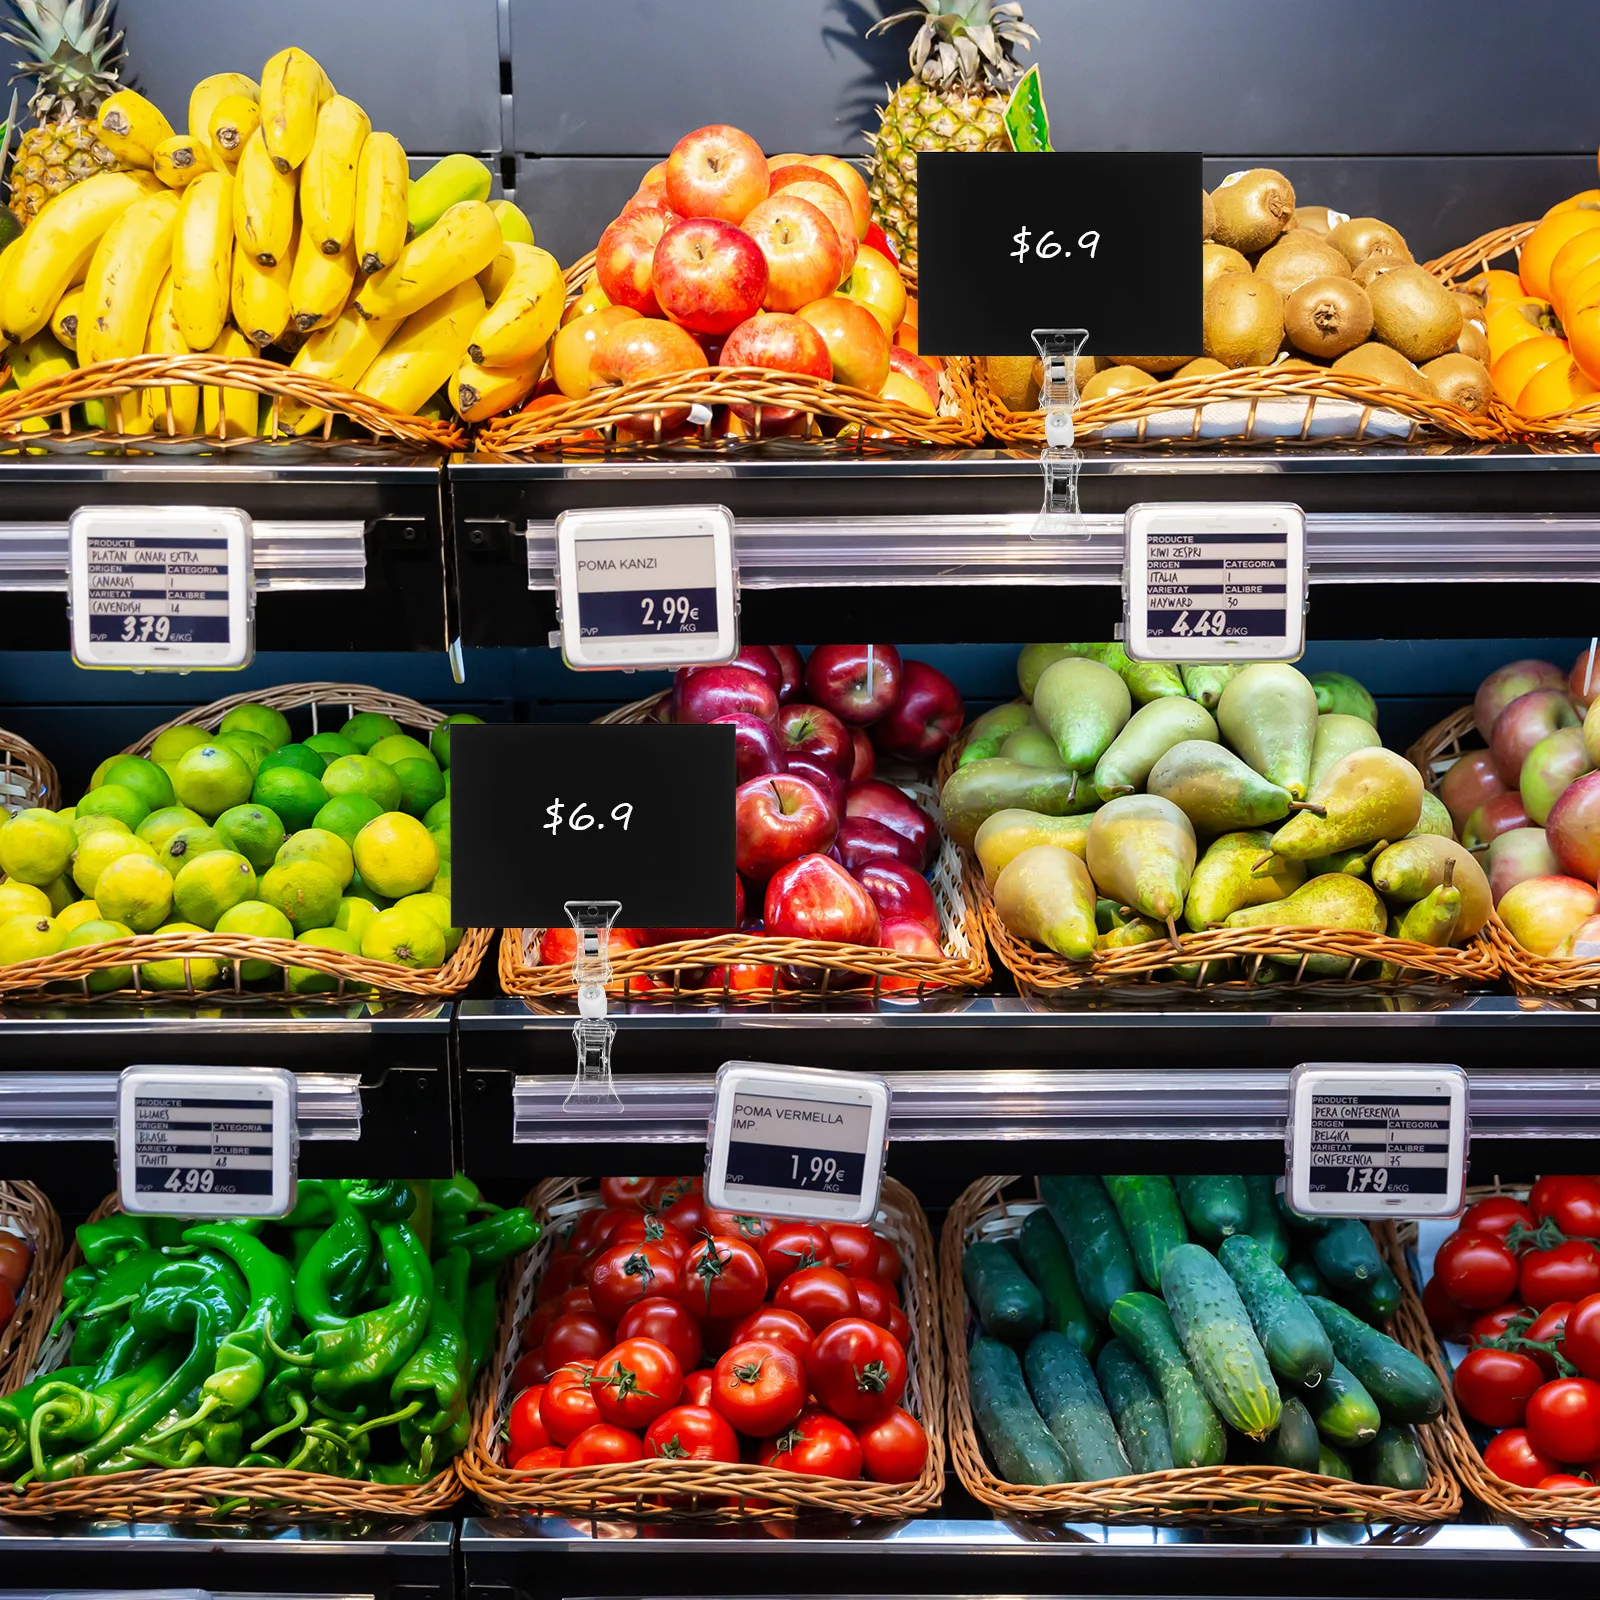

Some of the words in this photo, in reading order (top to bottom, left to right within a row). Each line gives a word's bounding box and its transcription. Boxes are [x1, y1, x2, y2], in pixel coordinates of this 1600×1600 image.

[1010, 225, 1101, 264] $6.9
[88, 539, 136, 548] PRODUCTE
[1146, 535, 1194, 543] PRODUCTE
[92, 550, 128, 562] PLATAN
[134, 550, 167, 562] CANARI
[169, 551, 199, 563] EXTRA
[1150, 547, 1169, 557] KIWI
[1172, 546, 1202, 558] ZESPRI
[88, 565, 122, 573] ORIGEN
[578, 559, 617, 571] POMA
[620, 558, 658, 569] KANZI
[1146, 561, 1180, 569] ORIGEN
[1225, 560, 1276, 568] CATEGORIA
[168, 566, 219, 574] CATEGORIA
[92, 575, 135, 588] CANARIAS
[1150, 571, 1179, 583] ITALIA
[88, 590, 132, 598] VARIETAT
[1146, 586, 1189, 594] VARIETAT
[1225, 585, 1263, 593] CALIBRE
[168, 591, 206, 600] CALIBRE
[1150, 597, 1193, 608] HAYWARD
[1227, 596, 1239, 607] 30
[92, 601, 141, 614] CAVENDISH
[171, 603, 180, 613] 14
[90, 633, 108, 641] PVP
[121, 615, 170, 642] 3,79
[679, 623, 697, 632] /KG
[1171, 610, 1227, 637] 4,49
[580, 627, 599, 636] PVP
[543, 798, 634, 836] $6.9
[136, 1099, 182, 1107] PRODUCTE
[1312, 1096, 1359, 1104] PRODUCTE
[139, 1109, 170, 1121] LLIMES
[734, 1104, 773, 1118] POMA
[776, 1108, 844, 1125] VERMELLA
[1315, 1106, 1338, 1118] PERA
[1341, 1106, 1401, 1119] CONFERENCIA
[136, 1122, 169, 1130] ORIGEN
[213, 1124, 263, 1132] CATEGORIA
[1312, 1120, 1345, 1128] ORIGEN
[1388, 1121, 1439, 1129] CATEGORIA
[139, 1131, 168, 1143] BRASIL
[1314, 1130, 1350, 1142] BELGICA
[136, 1145, 177, 1153] VARIETAT
[213, 1147, 250, 1155] CALIBRE
[1311, 1144, 1353, 1152] VARIETAT
[1388, 1145, 1425, 1153] CALIBRE
[140, 1155, 168, 1166] TAHITI
[1313, 1154, 1373, 1166] CONFERENCIA
[1390, 1155, 1401, 1167] 75
[164, 1168, 214, 1193] 4,99
[726, 1173, 744, 1183] PVP
[1310, 1184, 1327, 1192] PVP
[1346, 1166, 1389, 1193] 1,79
[823, 1183, 840, 1192] /KG
